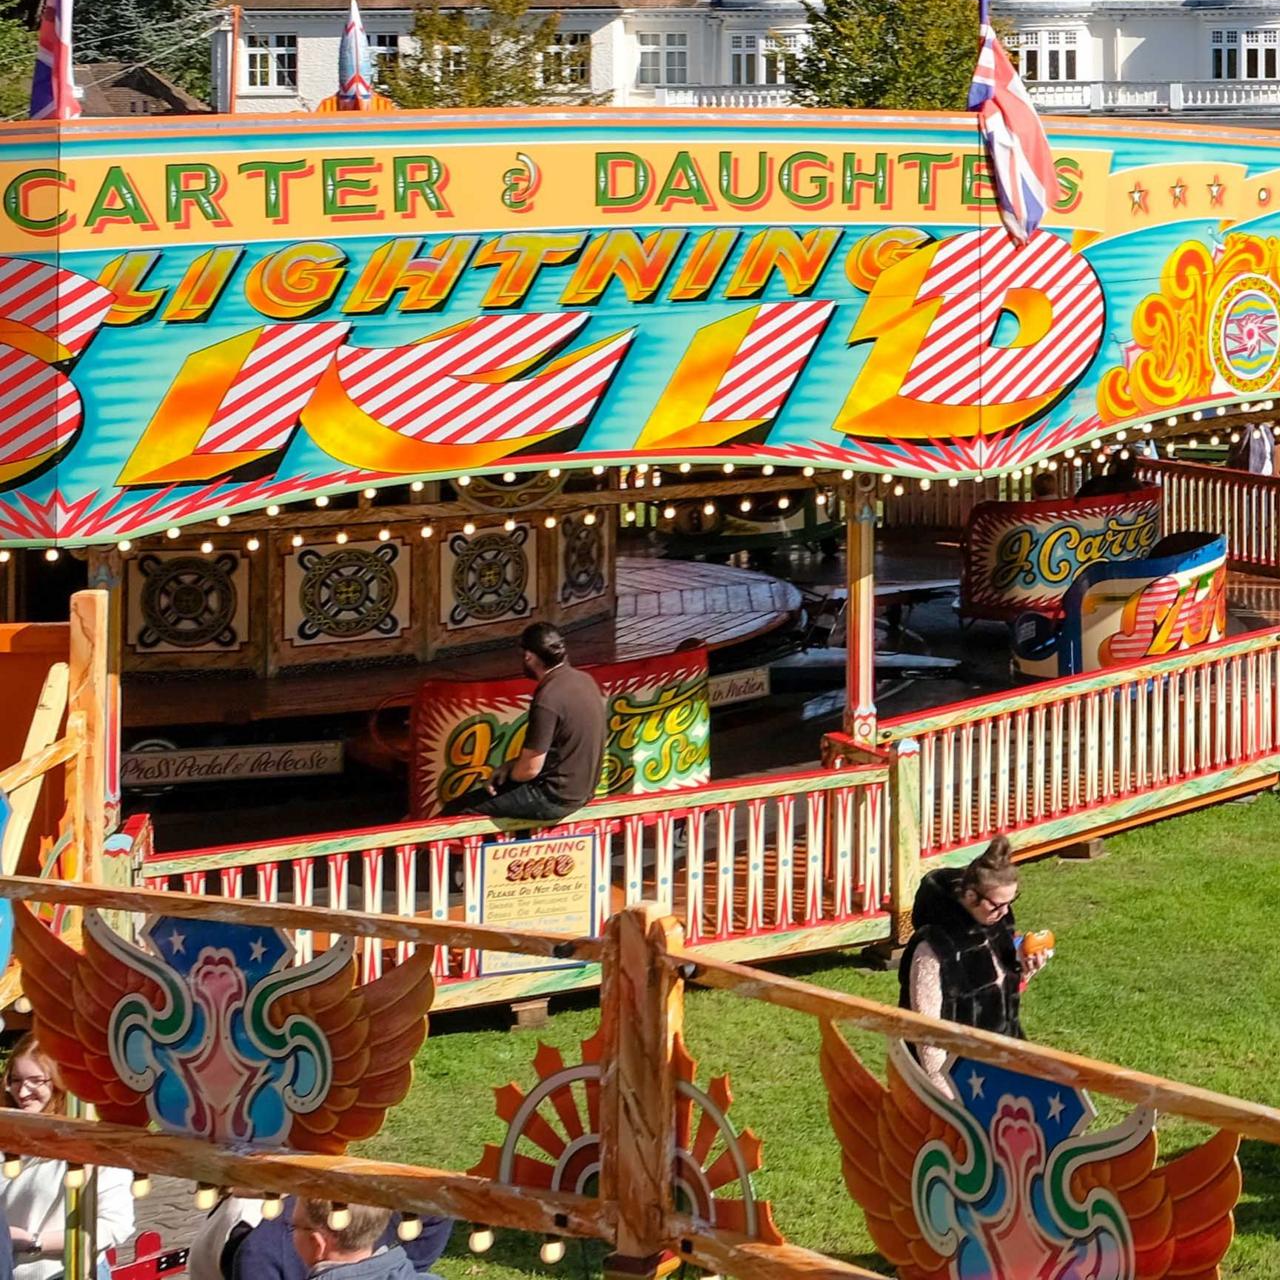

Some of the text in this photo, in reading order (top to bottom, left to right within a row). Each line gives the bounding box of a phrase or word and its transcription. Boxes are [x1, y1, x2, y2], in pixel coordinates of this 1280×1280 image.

[3, 154, 454, 237] CARTER
[595, 149, 1083, 216] DAUGHTES
[96, 226, 938, 326] LIGHTNING
[174, 751, 236, 778] Pedal
[492, 840, 586, 861] LIGHTNING
